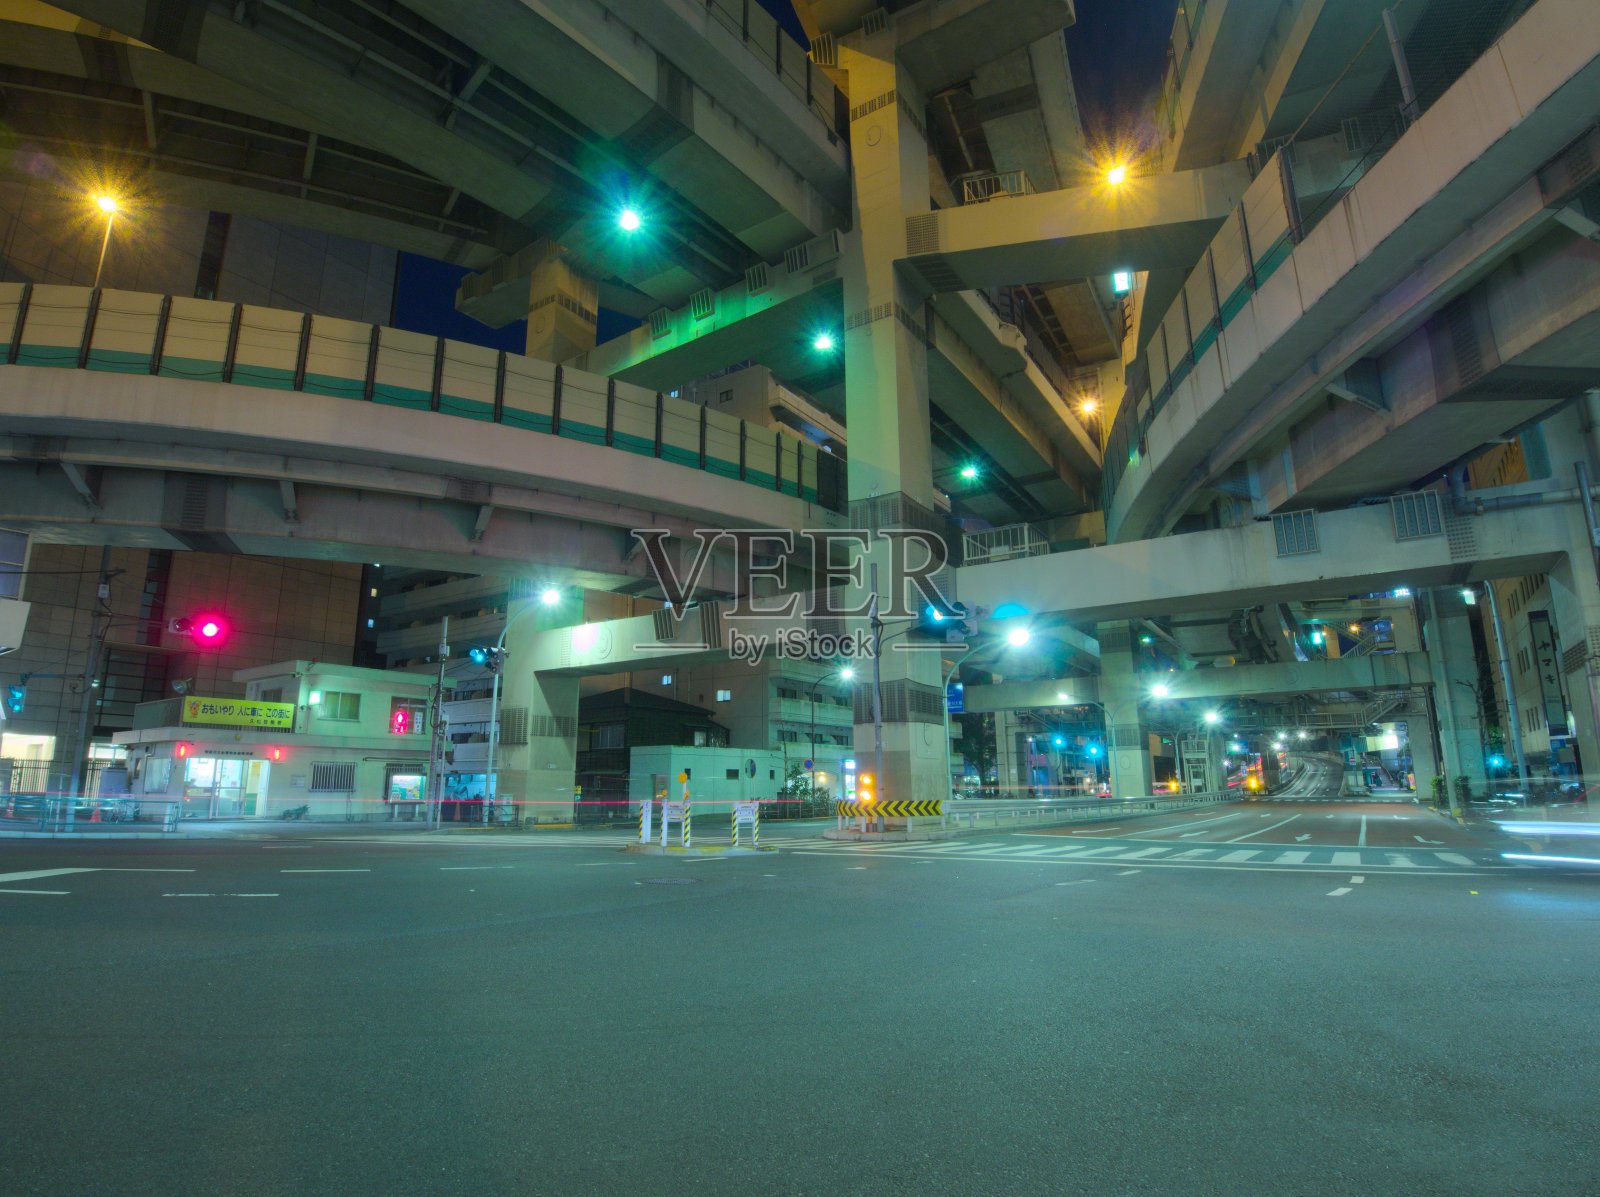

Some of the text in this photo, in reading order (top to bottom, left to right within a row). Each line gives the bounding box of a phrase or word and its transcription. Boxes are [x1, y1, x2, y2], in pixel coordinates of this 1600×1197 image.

[201, 703, 235, 716] おもいやり
[265, 708, 291, 719] この街に
